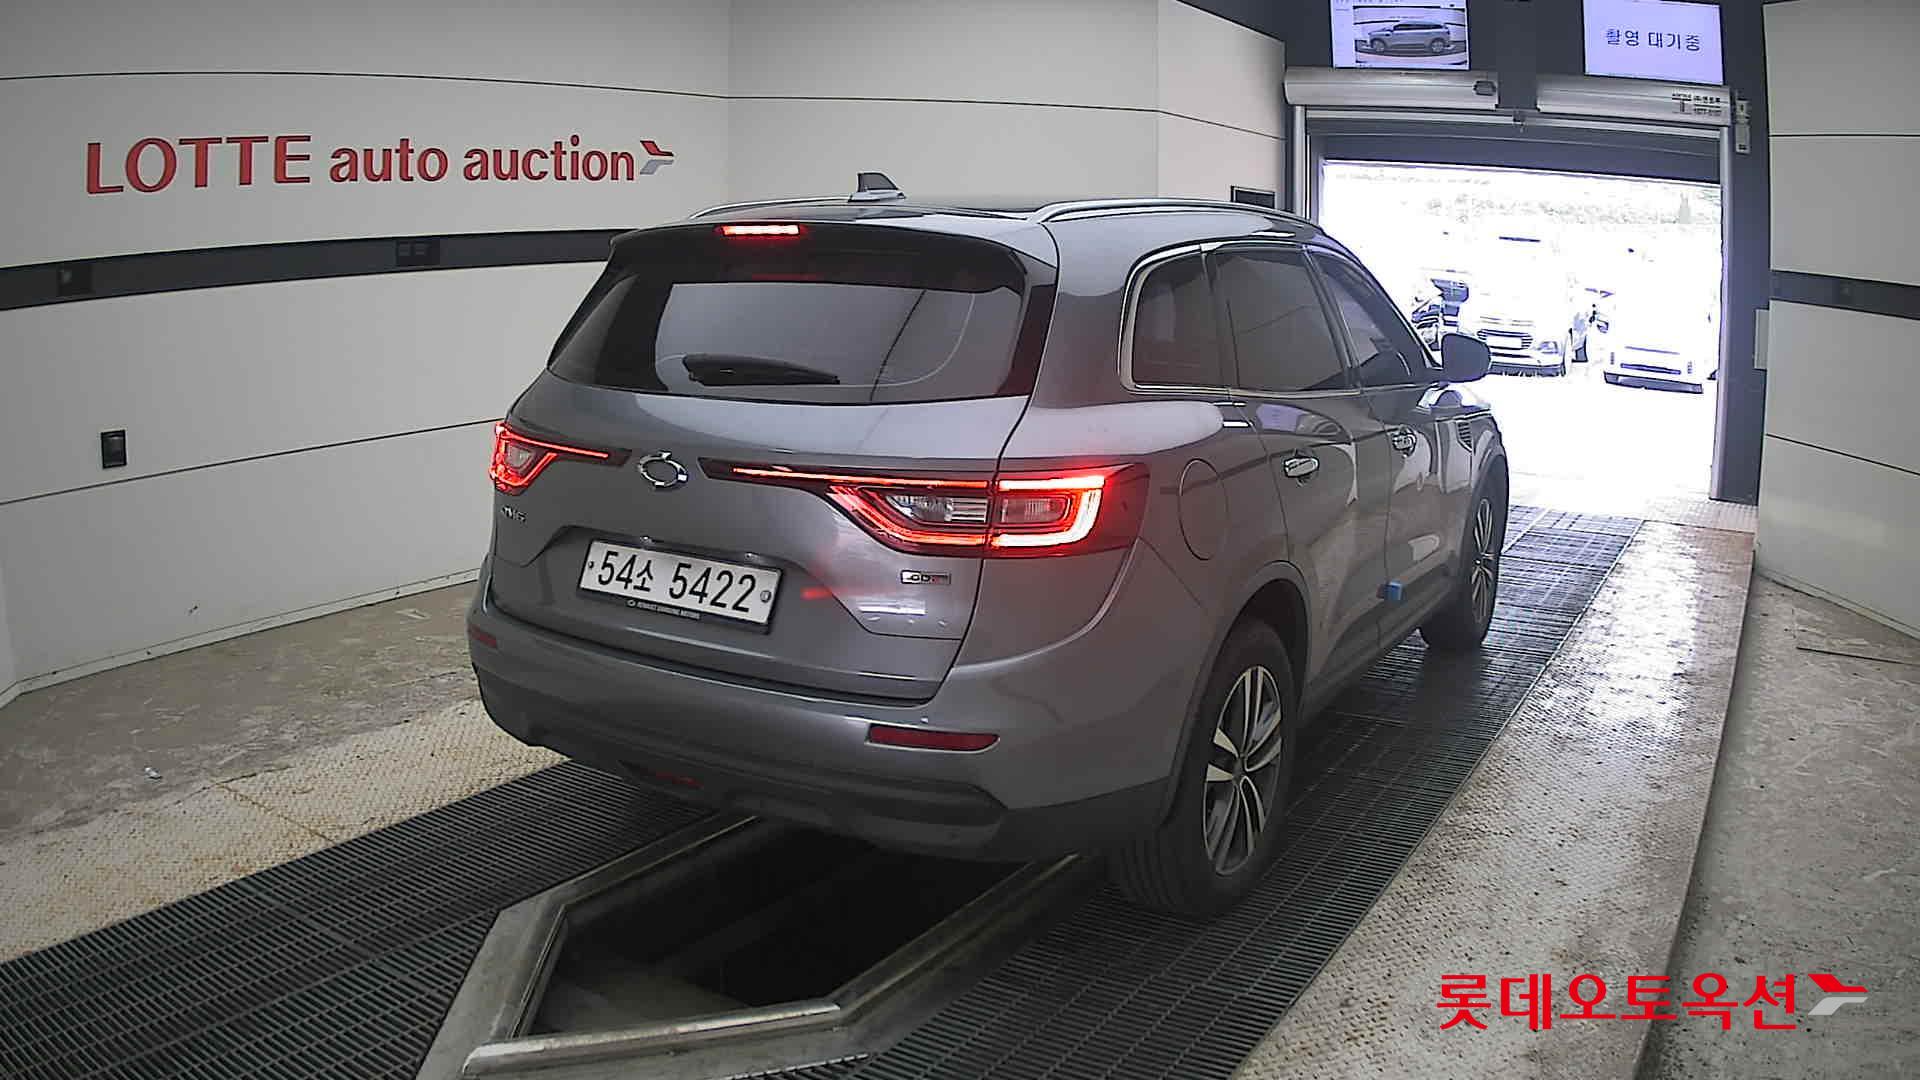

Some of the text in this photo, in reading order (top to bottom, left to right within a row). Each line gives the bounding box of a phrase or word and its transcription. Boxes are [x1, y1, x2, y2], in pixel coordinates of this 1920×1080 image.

[86, 135, 636, 194] LOTTE auto auction
[597, 550, 757, 613] 54소 5422
